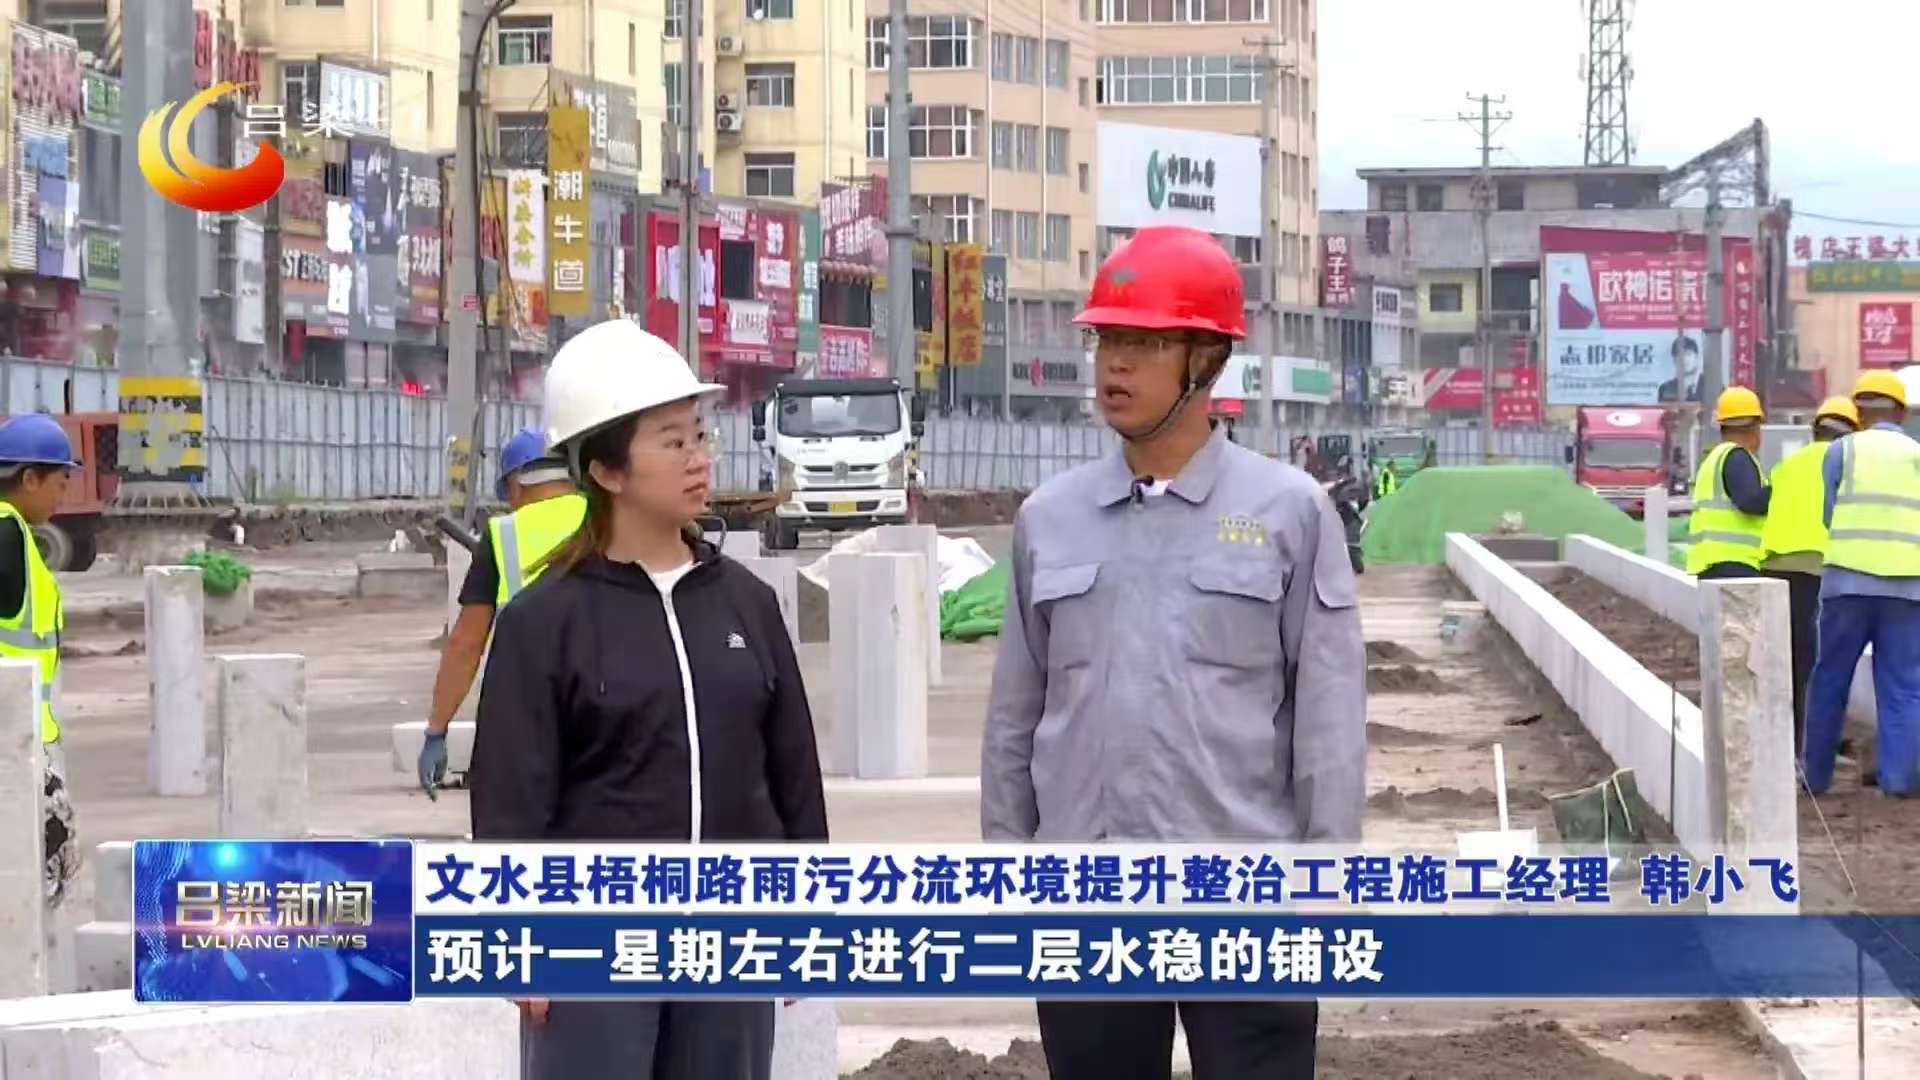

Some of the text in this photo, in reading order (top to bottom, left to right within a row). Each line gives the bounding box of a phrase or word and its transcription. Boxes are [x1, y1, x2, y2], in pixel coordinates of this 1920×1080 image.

[1168, 153, 1215, 188] 中国人寿
[1327, 237, 1347, 293] 鸽子王
[1559, 344, 1654, 366] 志邦家居
